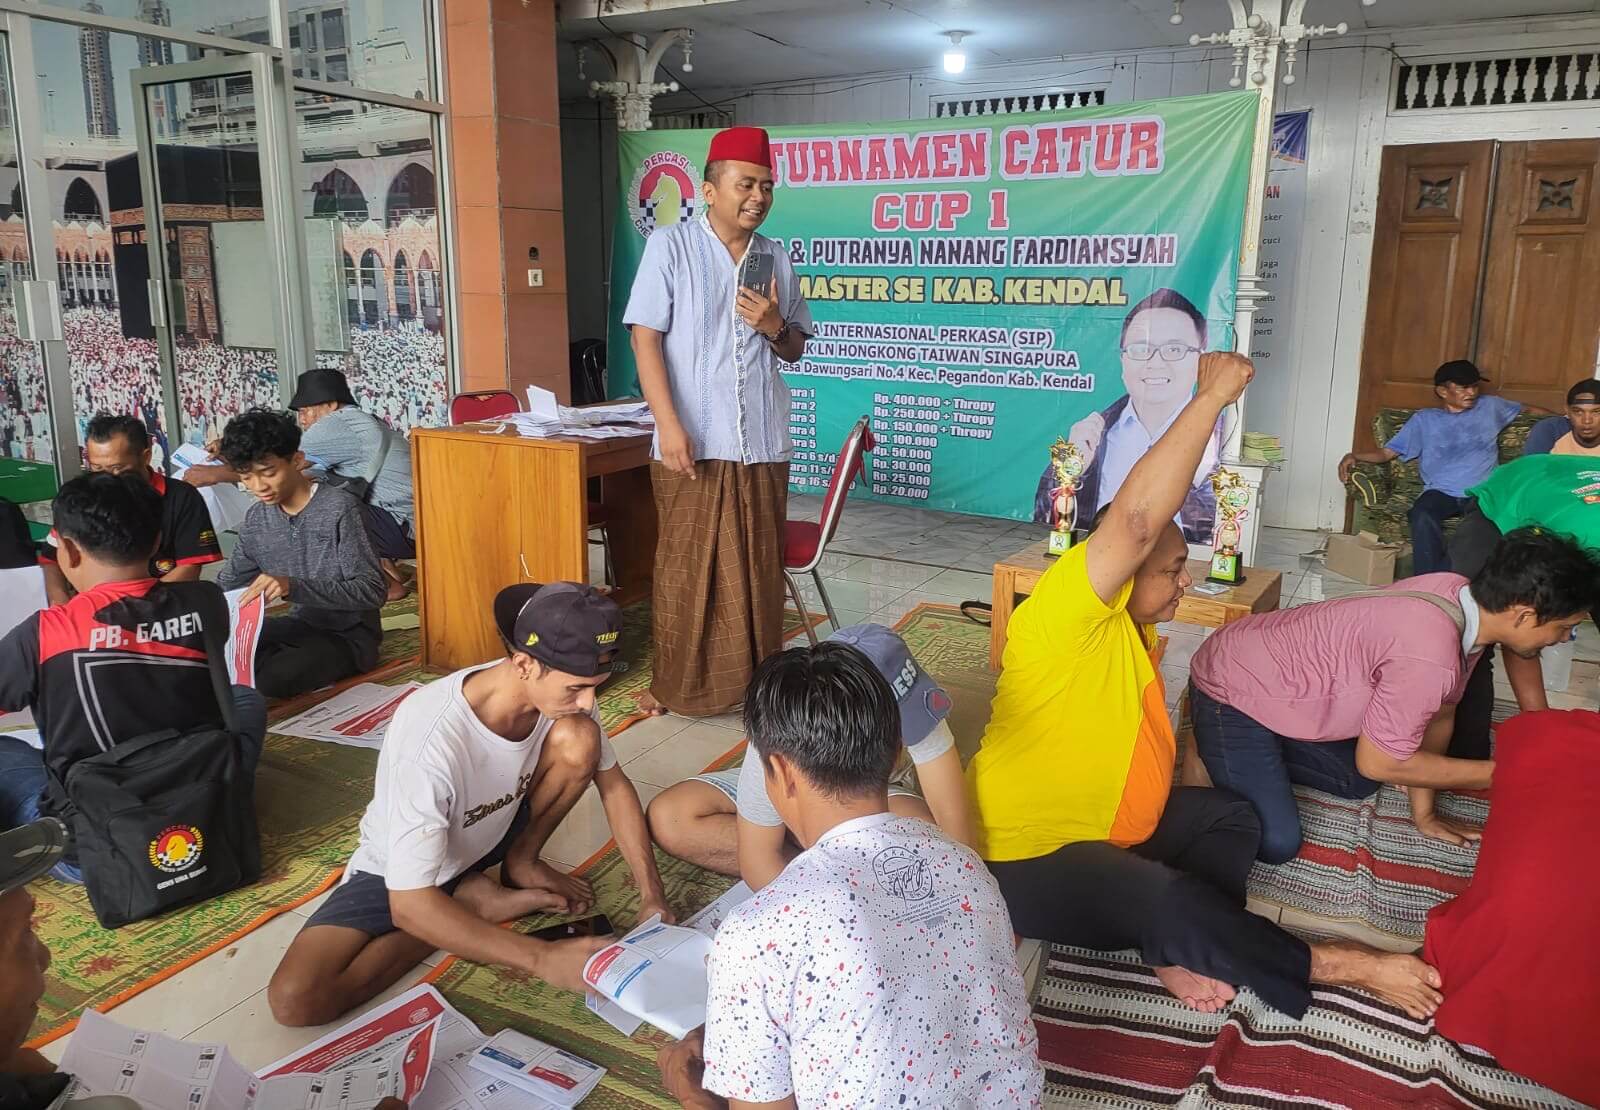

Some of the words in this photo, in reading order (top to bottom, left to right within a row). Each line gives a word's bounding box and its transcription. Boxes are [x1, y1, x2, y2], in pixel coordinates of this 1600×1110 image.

[643, 151, 690, 170] PERCASI
[769, 132, 987, 182] TURNAMEN
[1004, 120, 1160, 176] CATUR
[874, 192, 970, 230] CUP
[990, 190, 1008, 228] 1
[635, 218, 652, 237] CHE
[790, 239, 805, 264] &
[812, 239, 913, 265] PUTRANYA
[920, 239, 1007, 265] NANANG
[1012, 235, 1176, 266] FARDIANSYAH
[799, 276, 890, 301] MASTER
[893, 277, 926, 303] SE
[933, 278, 1000, 304] KAB.
[1004, 279, 1126, 304] KENDAL
[823, 323, 936, 341] INTERNASIONAL
[940, 328, 1007, 344] PERKASA
[1012, 330, 1053, 349] (SIP)
[818, 343, 834, 356] LN
[838, 344, 917, 361] HONGKONG
[921, 348, 980, 363] TAIWAN
[984, 350, 1078, 368] SINGAPURA
[804, 361, 873, 378] Dawungsari
[876, 366, 905, 379] No.4
[908, 367, 934, 381] Kec.
[938, 369, 1004, 385] Pegandon
[1008, 372, 1039, 387] Kab.
[1043, 374, 1092, 390] Kendal
[809, 388, 816, 398] 1
[874, 393, 892, 404] Rp.
[893, 394, 941, 408] 400.000
[953, 397, 996, 412] Thropy
[809, 401, 817, 411] 2
[808, 413, 816, 424] 3
[873, 406, 891, 417] Rp.
[893, 407, 941, 421] 250.000
[952, 411, 995, 426] Thropy
[808, 426, 816, 436] 4
[873, 419, 891, 430] Rp.
[892, 420, 939, 434] 150.000
[950, 425, 993, 440] Thropy
[809, 439, 816, 449] 5
[873, 432, 891, 443] Rp.
[892, 433, 939, 448] 100.000
[809, 451, 816, 461] 6
[873, 446, 890, 457] Rp.
[891, 446, 932, 460] 50.000
[810, 464, 819, 474] 11
[872, 458, 890, 469] Rp.
[891, 459, 932, 474] 30.000
[809, 476, 820, 487] 16
[872, 471, 890, 482] Rp.
[891, 472, 931, 486] 25.000
[872, 483, 889, 495] Rp.
[890, 485, 929, 499] 20.000
[88, 624, 129, 652] PB.
[890, 658, 917, 701] ESS
